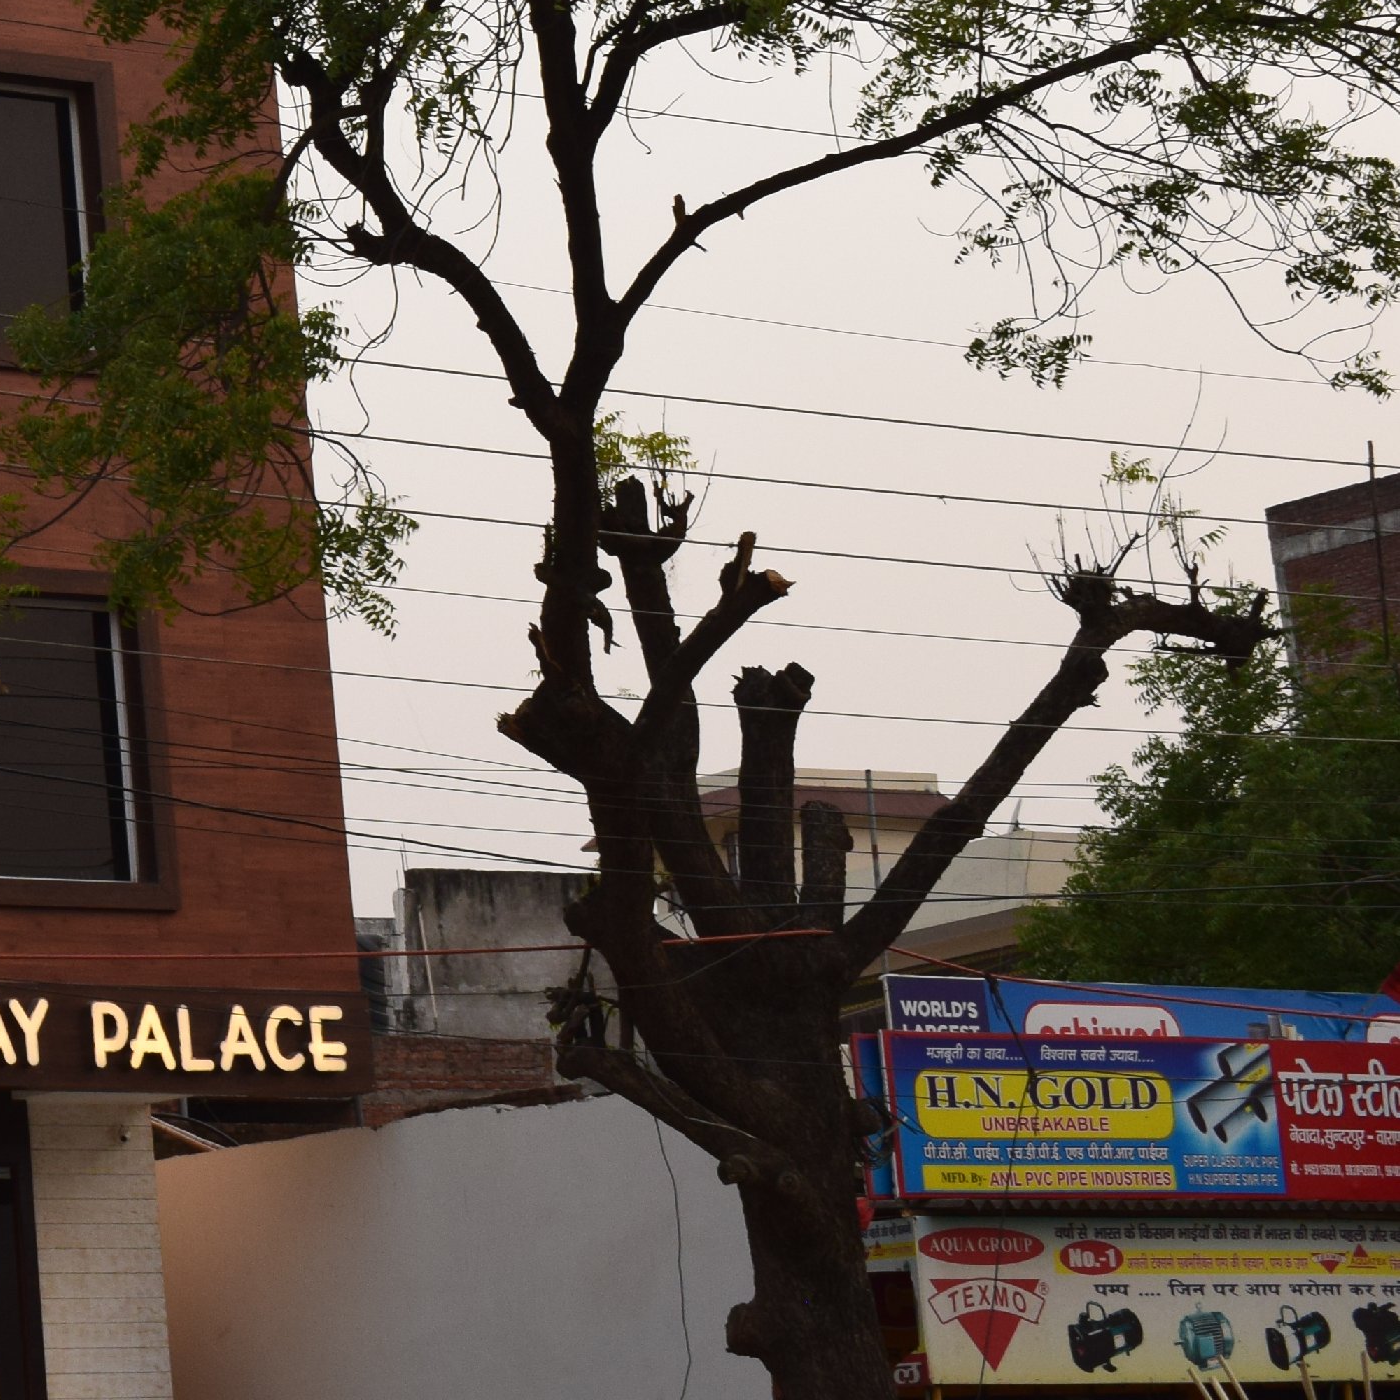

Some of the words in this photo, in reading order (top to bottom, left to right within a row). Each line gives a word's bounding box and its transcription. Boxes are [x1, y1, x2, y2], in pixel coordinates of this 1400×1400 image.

[900, 1000, 979, 1019] WORLD'S
[90, 1001, 350, 1073] PALACE
[967, 1048, 980, 1060] का
[1040, 1044, 1077, 1062] विश्वास
[1081, 1046, 1107, 1062] सबसे
[922, 1074, 1017, 1110] H.N.
[1027, 1075, 1159, 1111] GOLD
[1278, 1057, 1344, 1117] पटेल
[981, 1116, 1111, 1133] UNBREAKABLE
[990, 1172, 1022, 1187] ANIL
[1025, 1172, 1054, 1187] PVC
[1057, 1172, 1088, 1187] PIPE
[1091, 1172, 1172, 1187] INDUSTRIES
[930, 1236, 975, 1255] AQUA
[978, 1236, 1033, 1253] GROUP
[1093, 1283, 1130, 1298] पम्प
[1167, 1279, 1205, 1298] जिन
[1213, 1283, 1237, 1298] पर
[1246, 1283, 1280, 1298] आप
[1288, 1280, 1343, 1298] भरोसा
[1349, 1283, 1375, 1298] कर
[947, 1284, 1028, 1314] TEXMO
